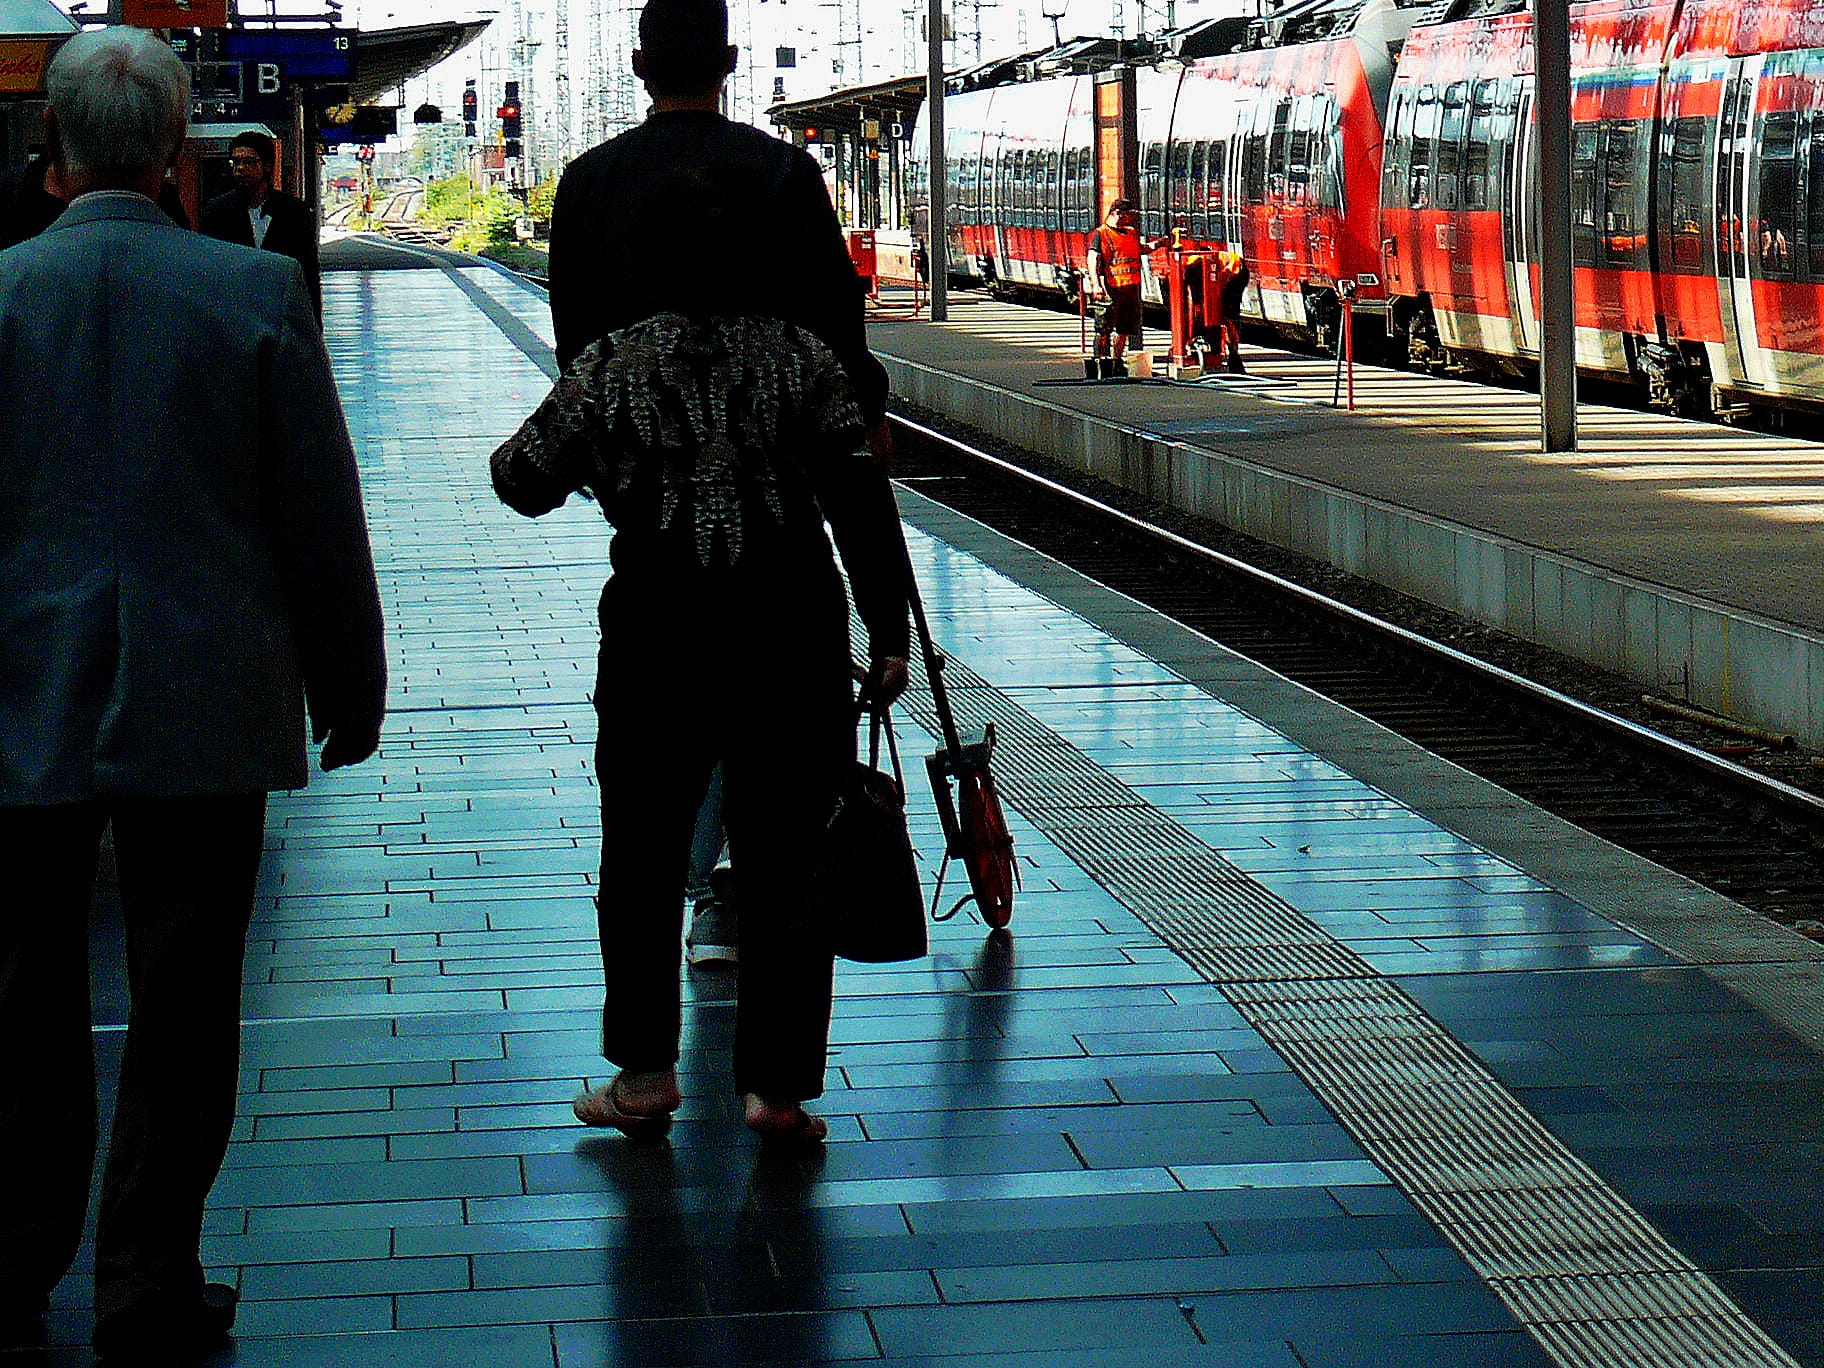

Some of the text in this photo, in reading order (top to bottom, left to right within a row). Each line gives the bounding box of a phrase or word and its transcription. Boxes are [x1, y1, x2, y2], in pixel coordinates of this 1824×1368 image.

[333, 37, 350, 50] 13
[257, 63, 281, 95] B
[890, 123, 904, 138] D
